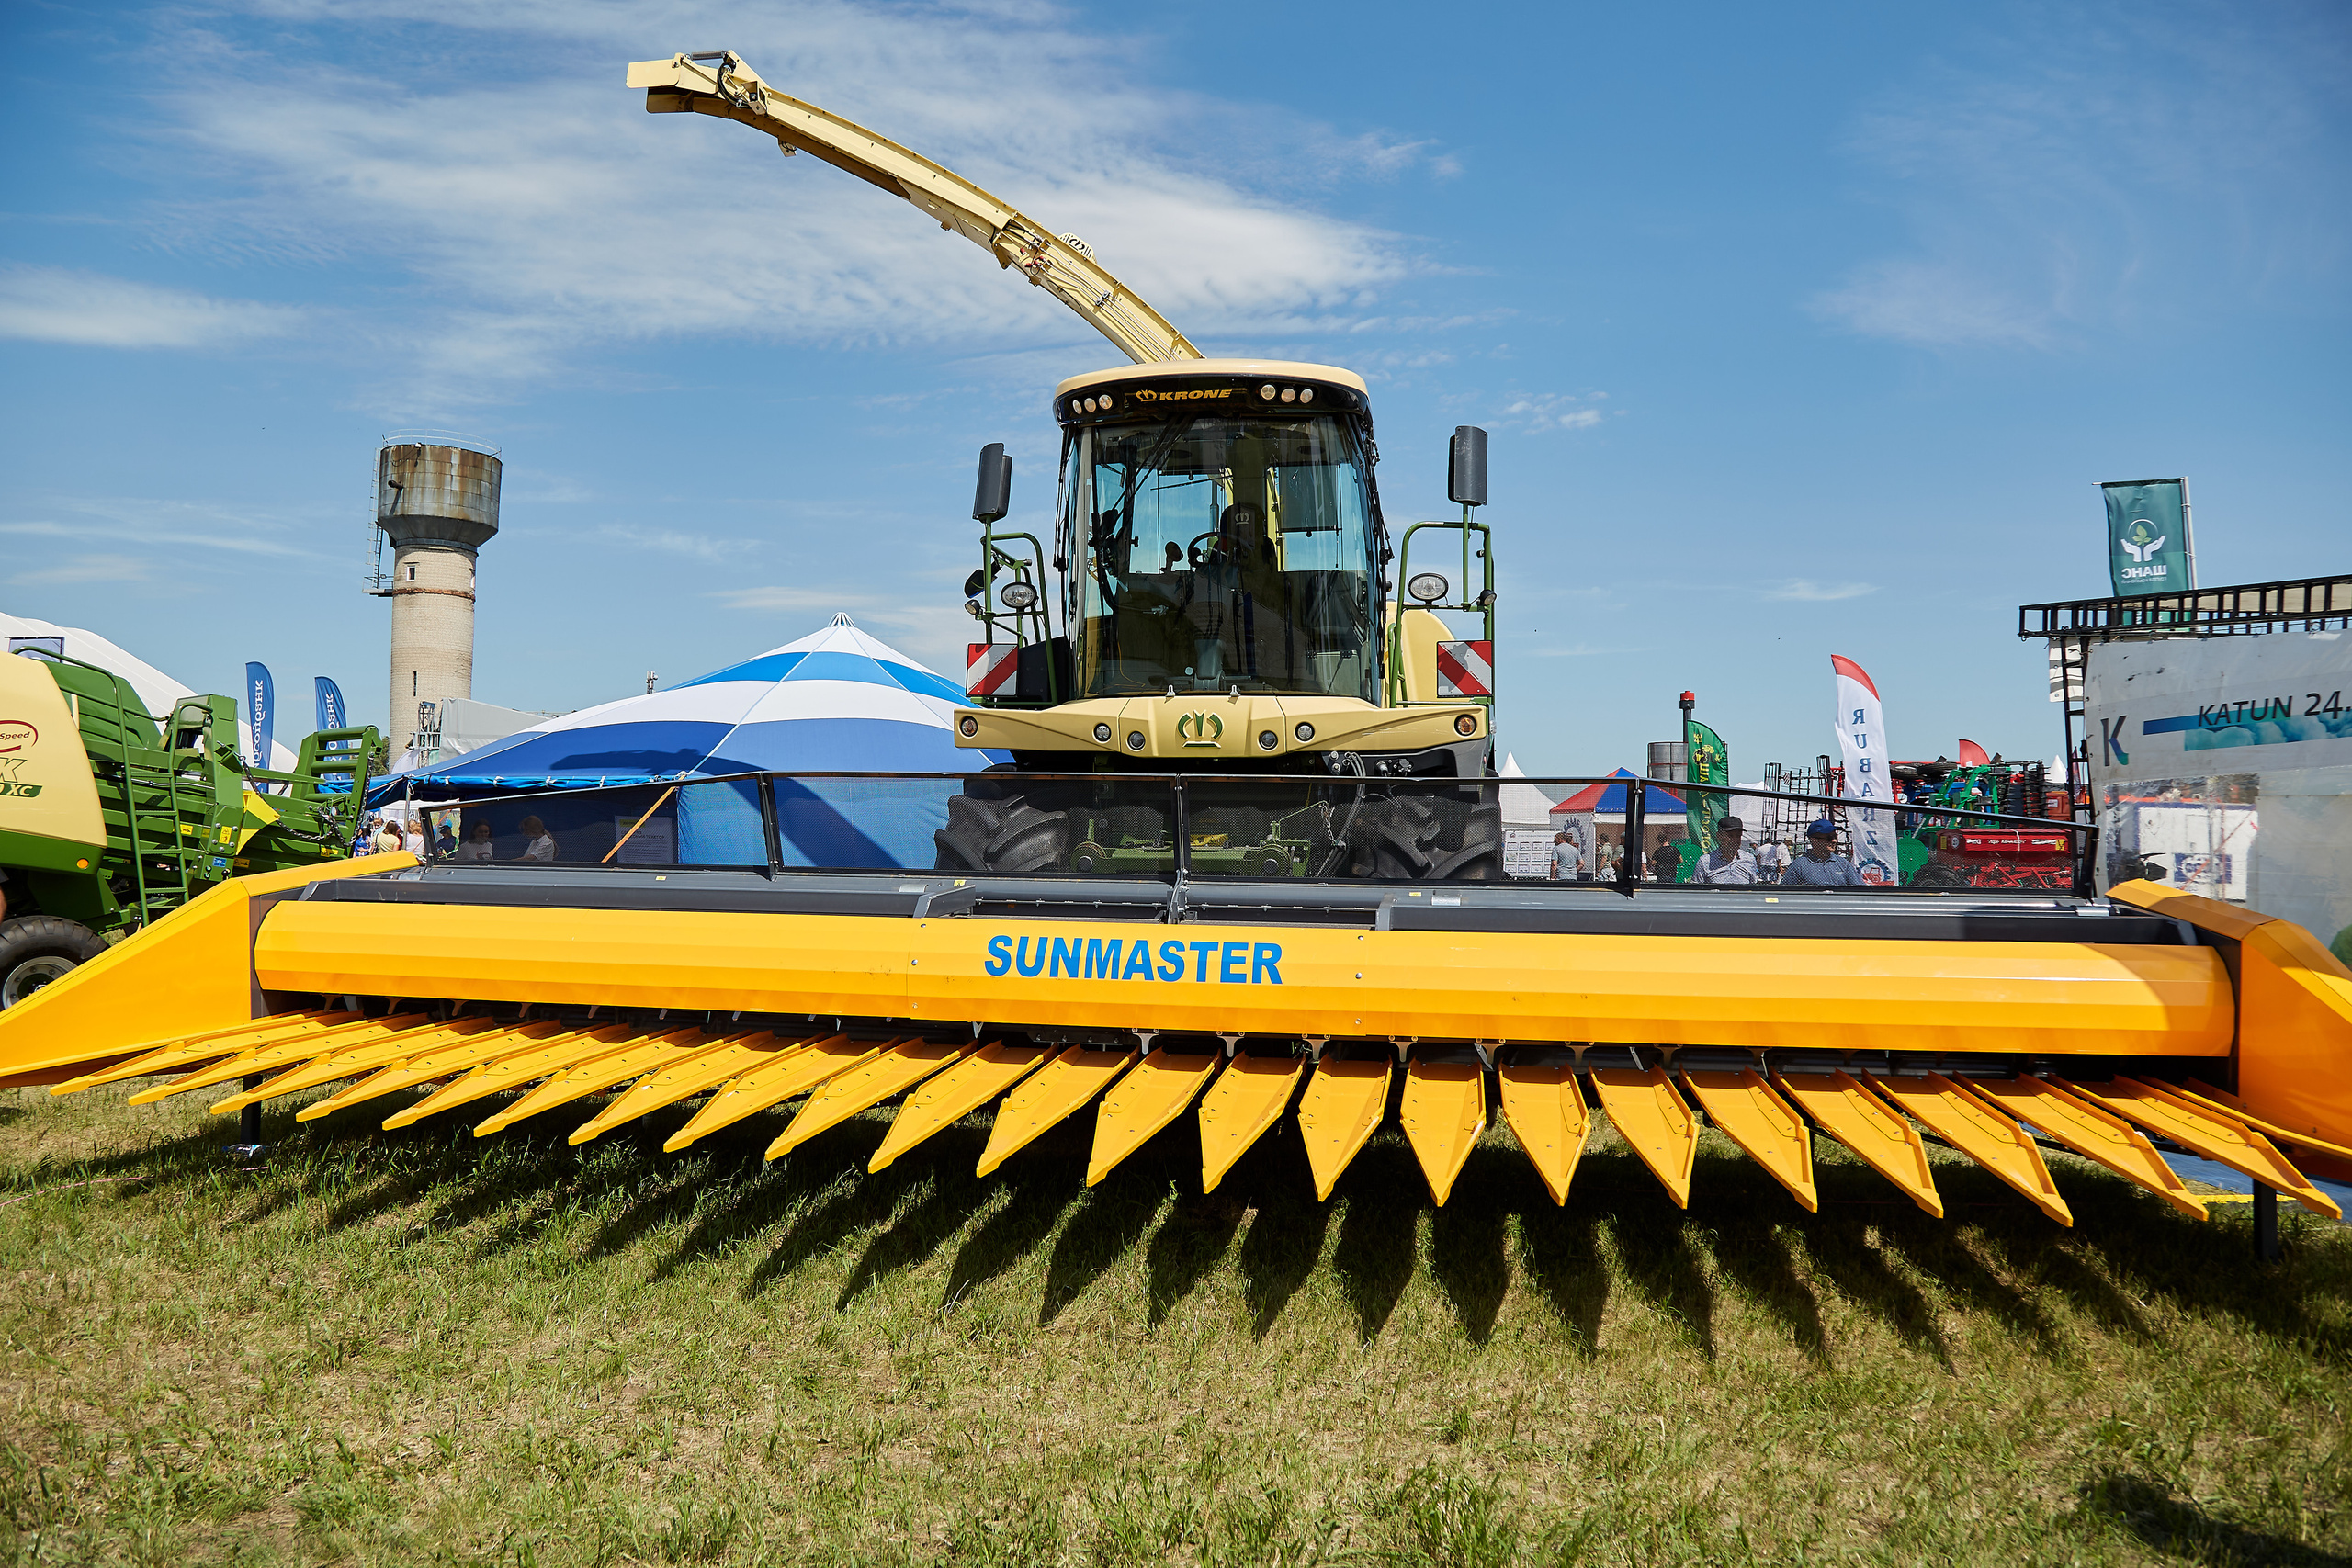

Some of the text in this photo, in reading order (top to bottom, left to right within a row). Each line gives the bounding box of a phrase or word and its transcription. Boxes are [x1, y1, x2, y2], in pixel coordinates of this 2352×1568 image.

[1159, 389, 1233, 401] KRONE
[2199, 695, 2293, 727] KATUN
[985, 935, 1283, 984] SUNMASTER
